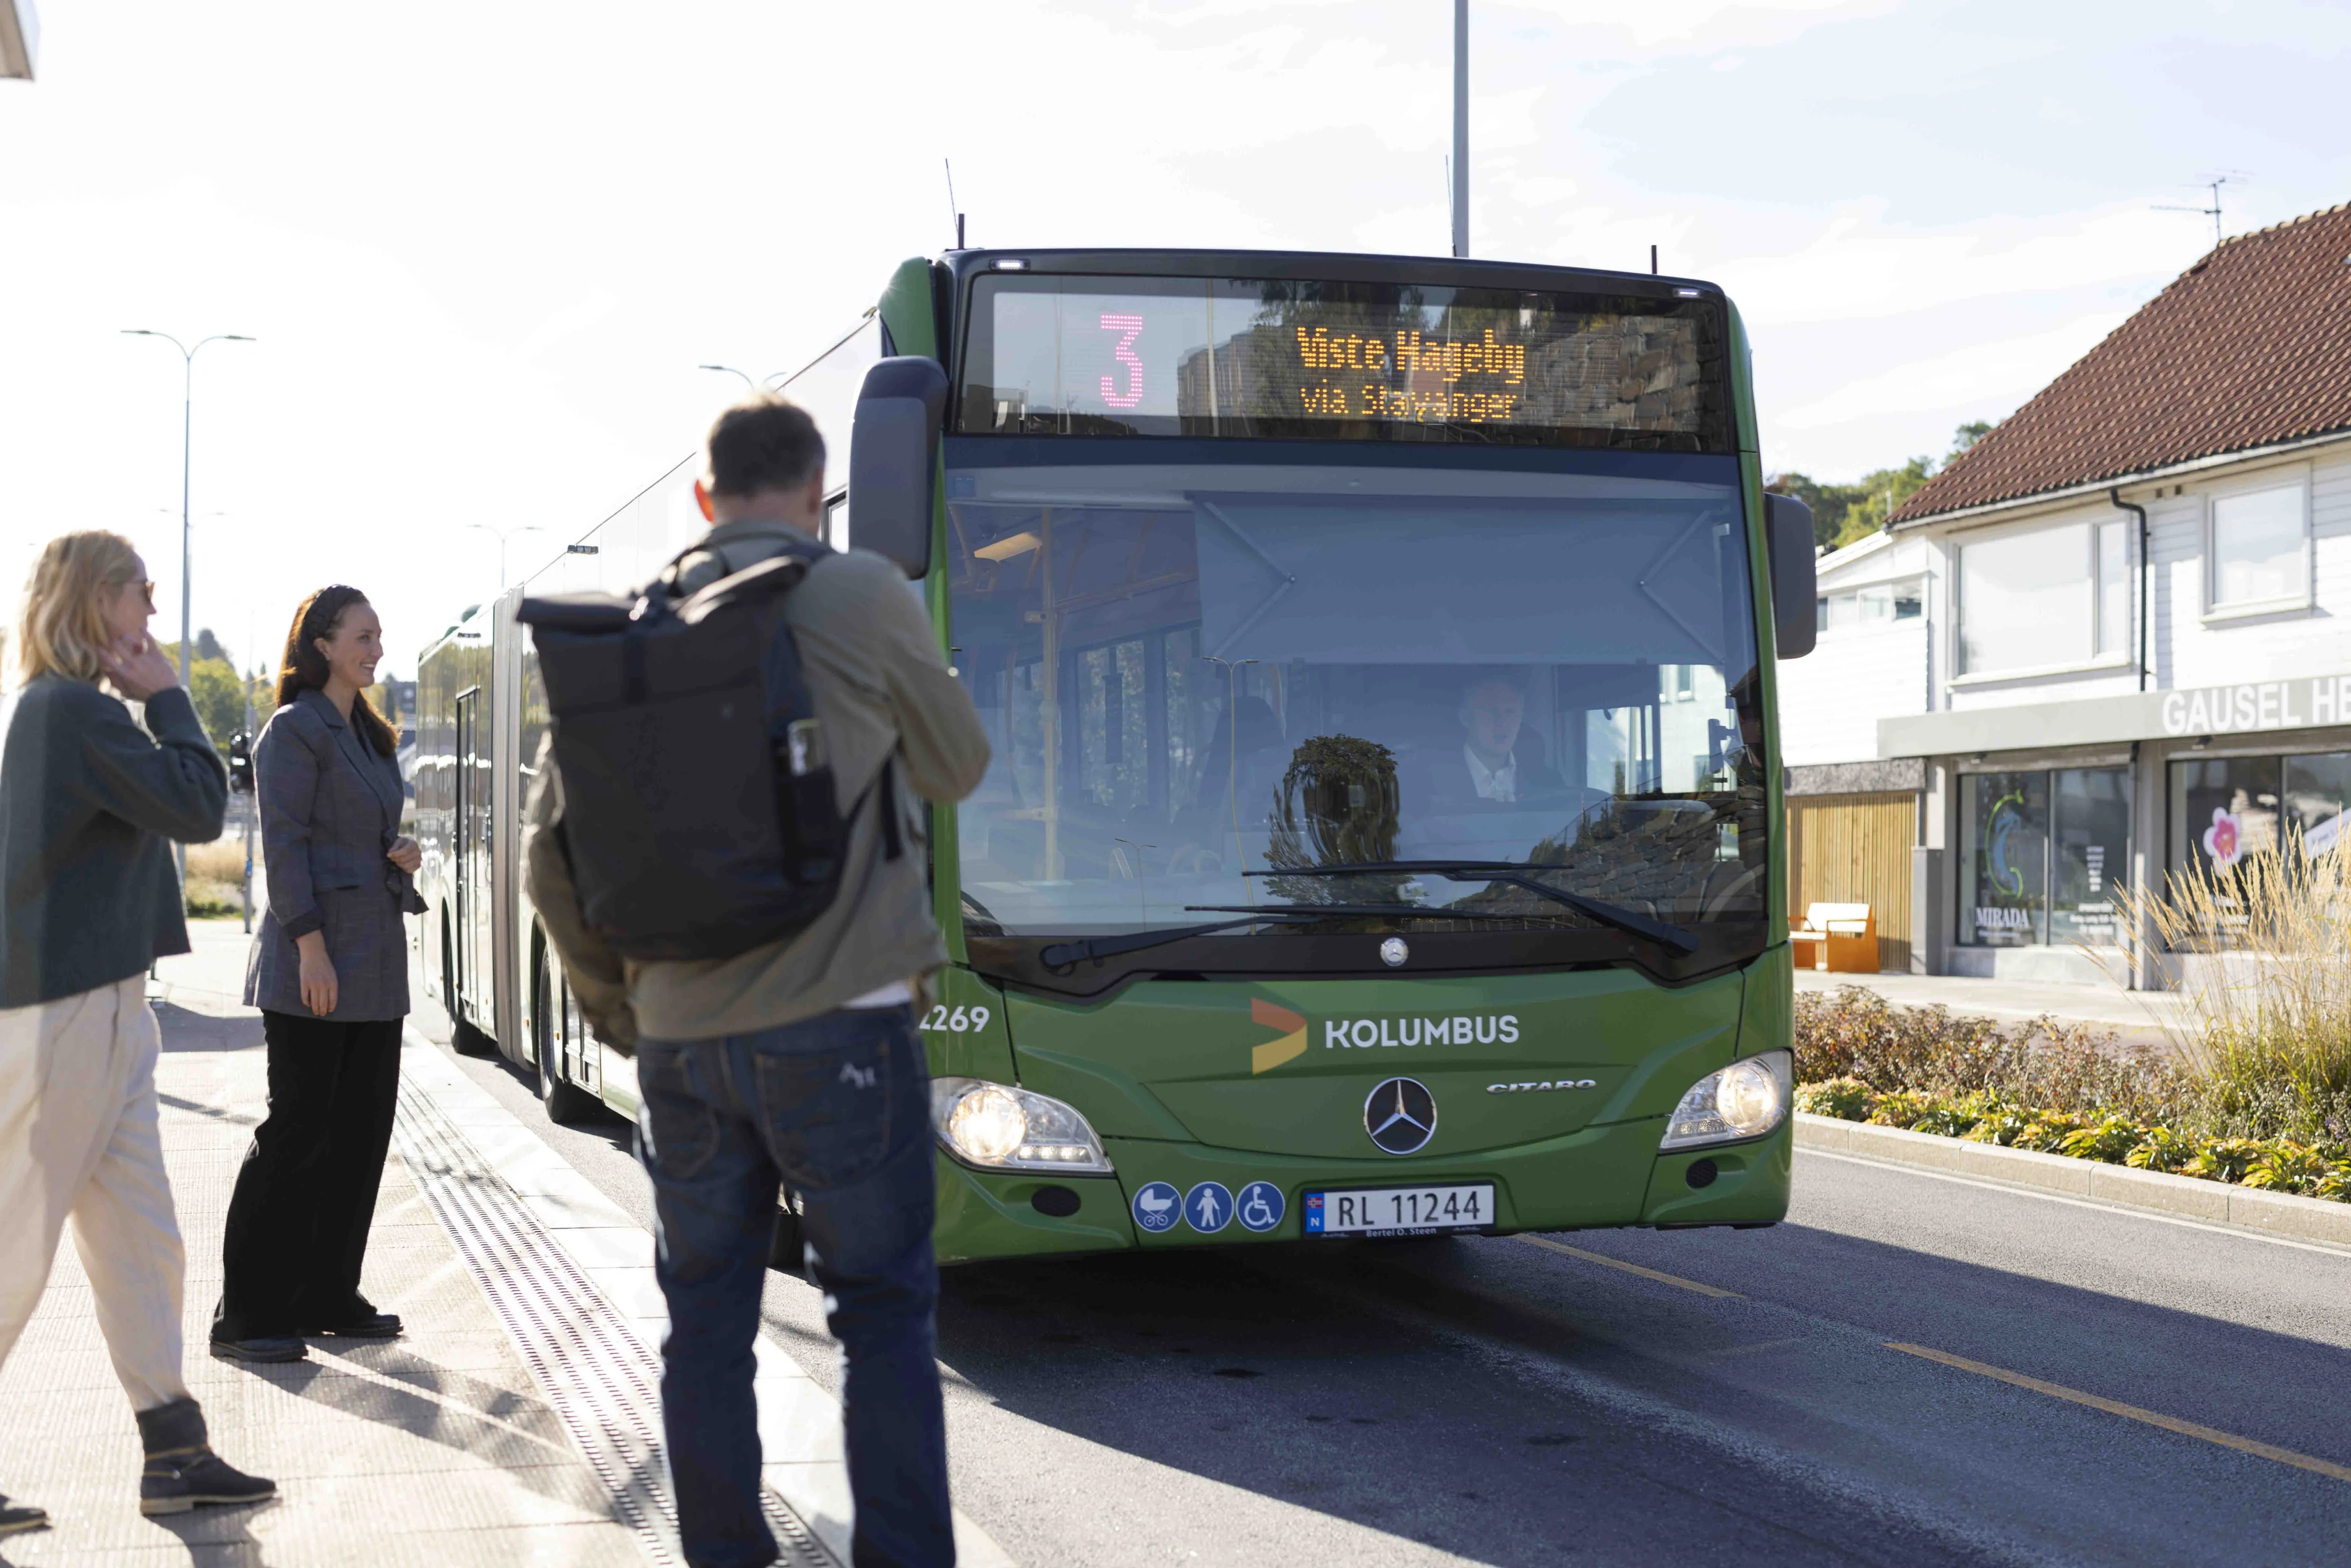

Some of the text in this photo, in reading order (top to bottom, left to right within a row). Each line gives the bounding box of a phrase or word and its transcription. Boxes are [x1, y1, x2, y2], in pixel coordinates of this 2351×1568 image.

[1100, 314, 1142, 407] 3
[1297, 327, 1524, 383] Viste Hageby
[1300, 378, 1517, 423] via Stavanger
[2162, 682, 2301, 735] GAUSEL
[1975, 907, 2030, 928] MIRADA
[1325, 1015, 1520, 1049] KOLUMBUS
[1486, 1078, 1597, 1095] CITARO
[1310, 1217, 1320, 1227] N
[1339, 1191, 1480, 1226] RL 11244
[1366, 1227, 1437, 1238] Bertel O. Steen
